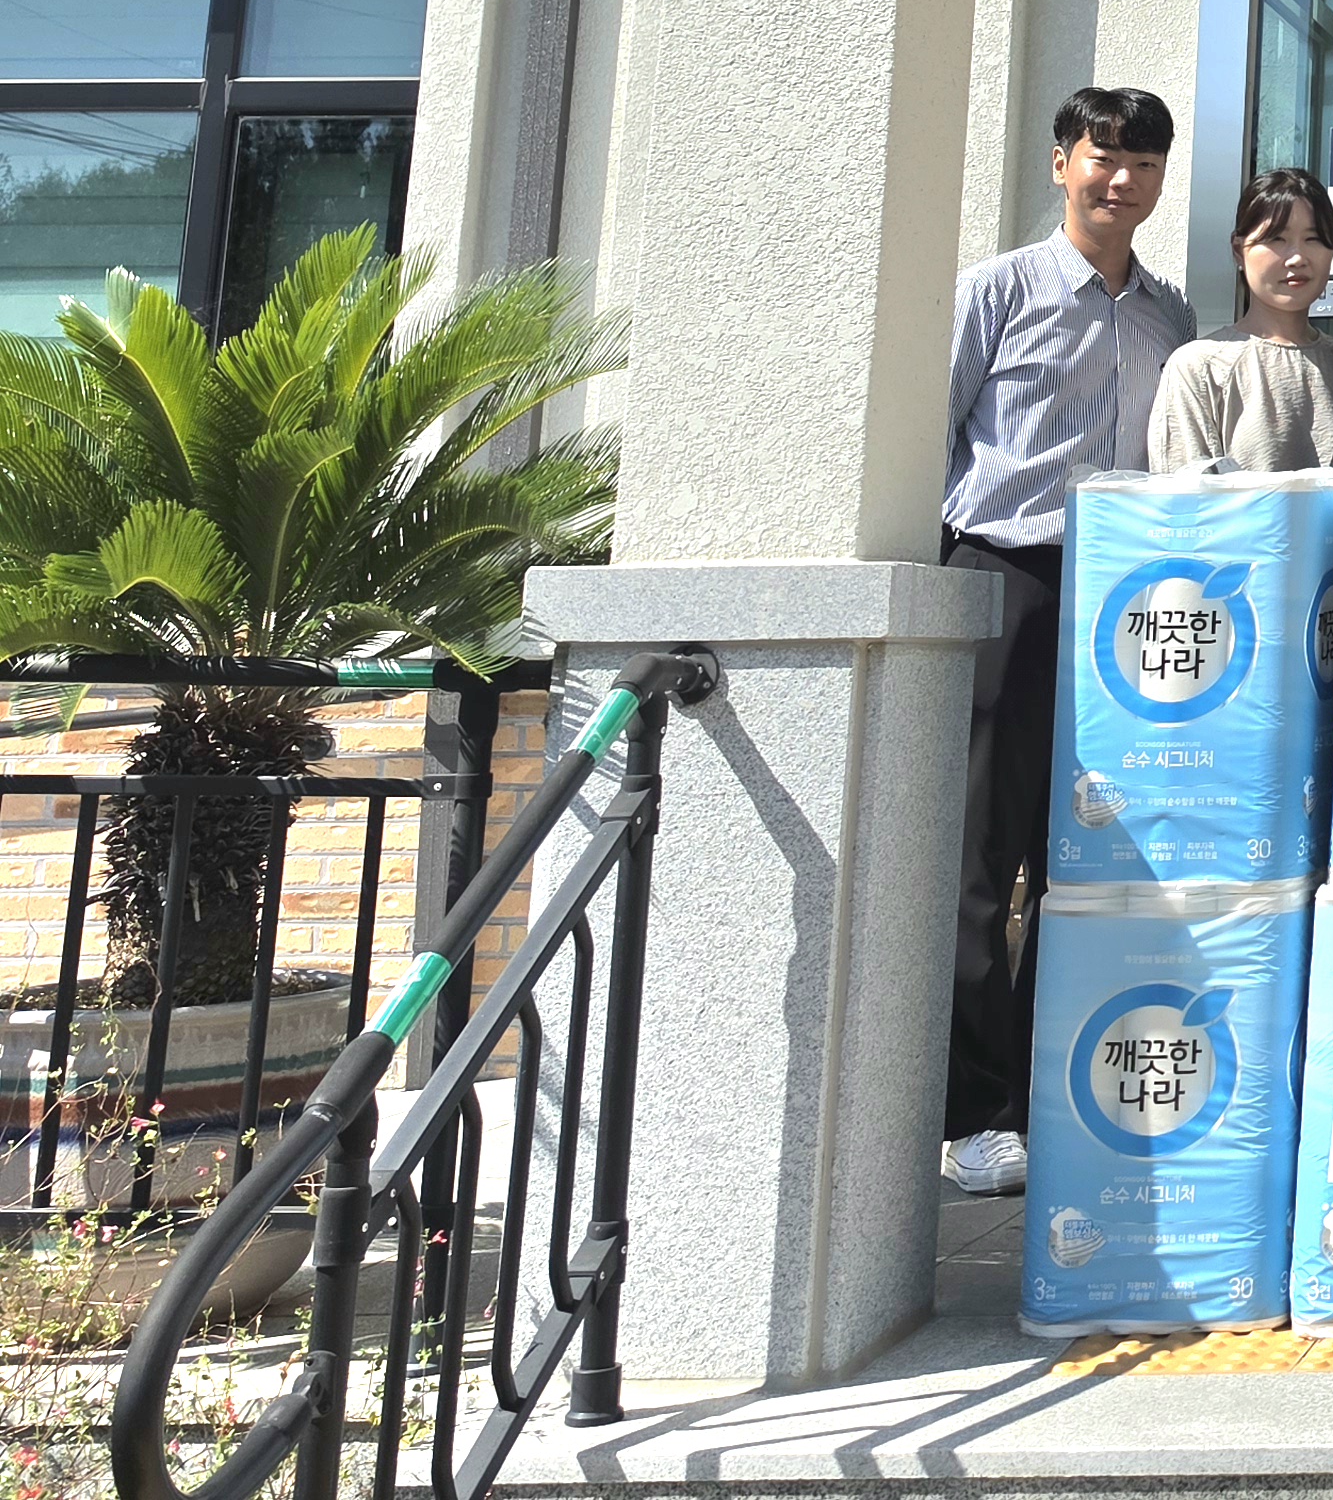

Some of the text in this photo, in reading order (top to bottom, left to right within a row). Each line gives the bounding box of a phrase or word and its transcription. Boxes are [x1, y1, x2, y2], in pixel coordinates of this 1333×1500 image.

[1127, 610, 1221, 645] 깨끗한
[1141, 648, 1205, 680] 나라
[1121, 750, 1214, 768] 순수 시그니처
[1059, 837, 1081, 861] 3겹
[1247, 838, 1271, 860] 30
[1104, 1039, 1202, 1076] 깨끗한
[1119, 1079, 1185, 1112] 나라
[1100, 1185, 1196, 1204] 순수 시그니처
[1034, 1277, 1056, 1300] 3겹
[1228, 1277, 1254, 1299] 30
[1307, 1275, 1331, 1300] 3겹
